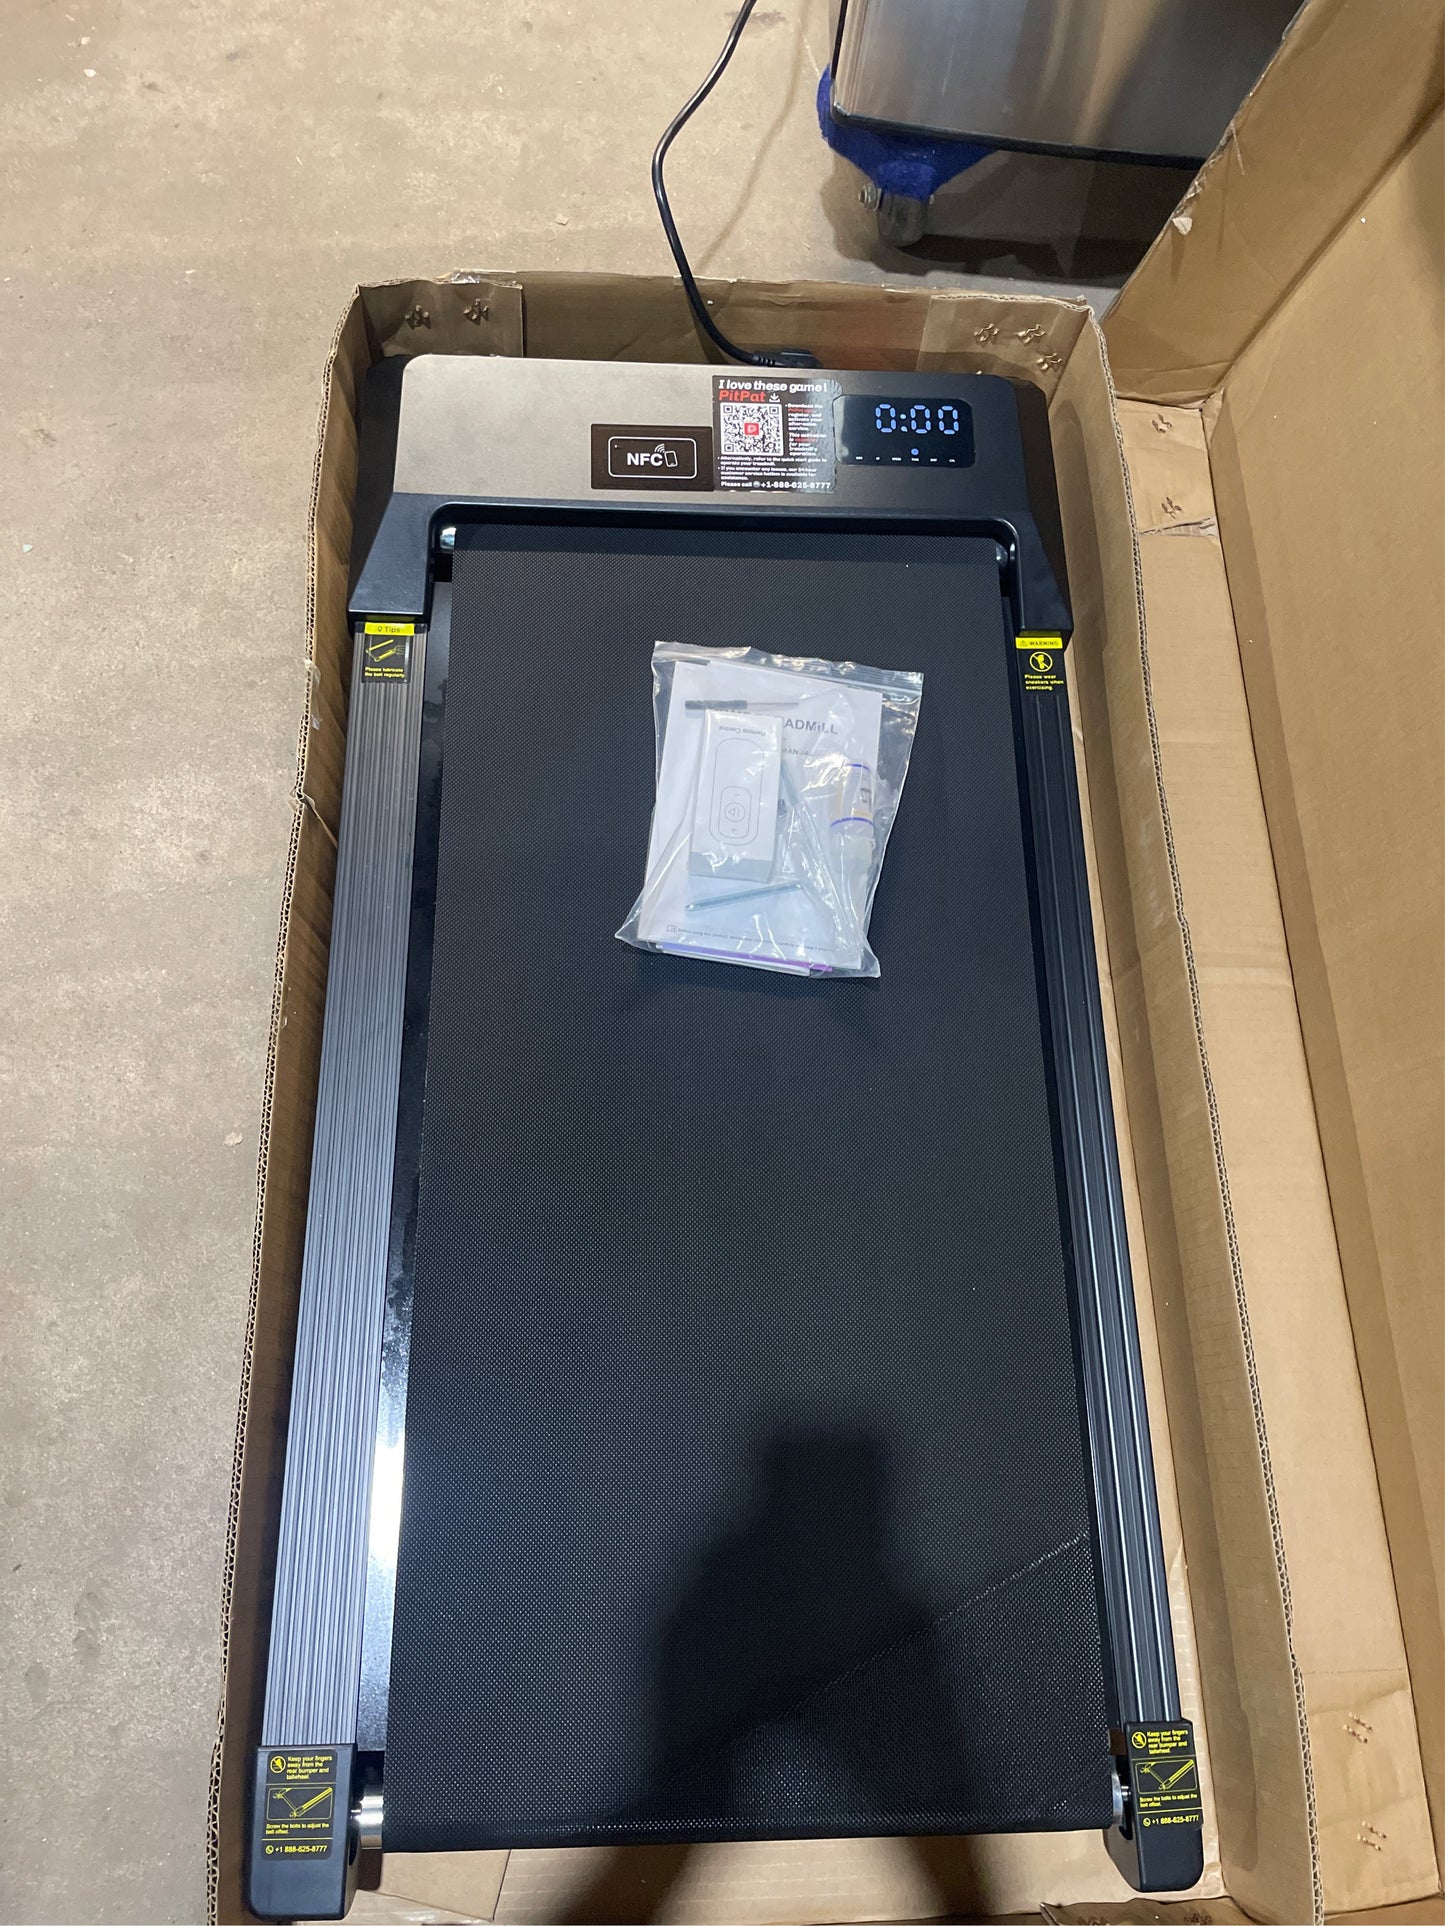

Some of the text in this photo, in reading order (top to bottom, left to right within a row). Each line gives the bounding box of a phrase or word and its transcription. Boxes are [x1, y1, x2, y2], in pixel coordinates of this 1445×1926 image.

[718, 379, 725, 389] I
[726, 379, 752, 390] love
[753, 380, 788, 391] these
[718, 389, 766, 402] PitPat
[875, 403, 959, 435] 0:00
[626, 452, 663, 466] NFC
[783, 718, 839, 735] ADMILL
[314, 1755, 333, 1763] fingers
[284, 1845, 328, 1853] 888-625-8777
